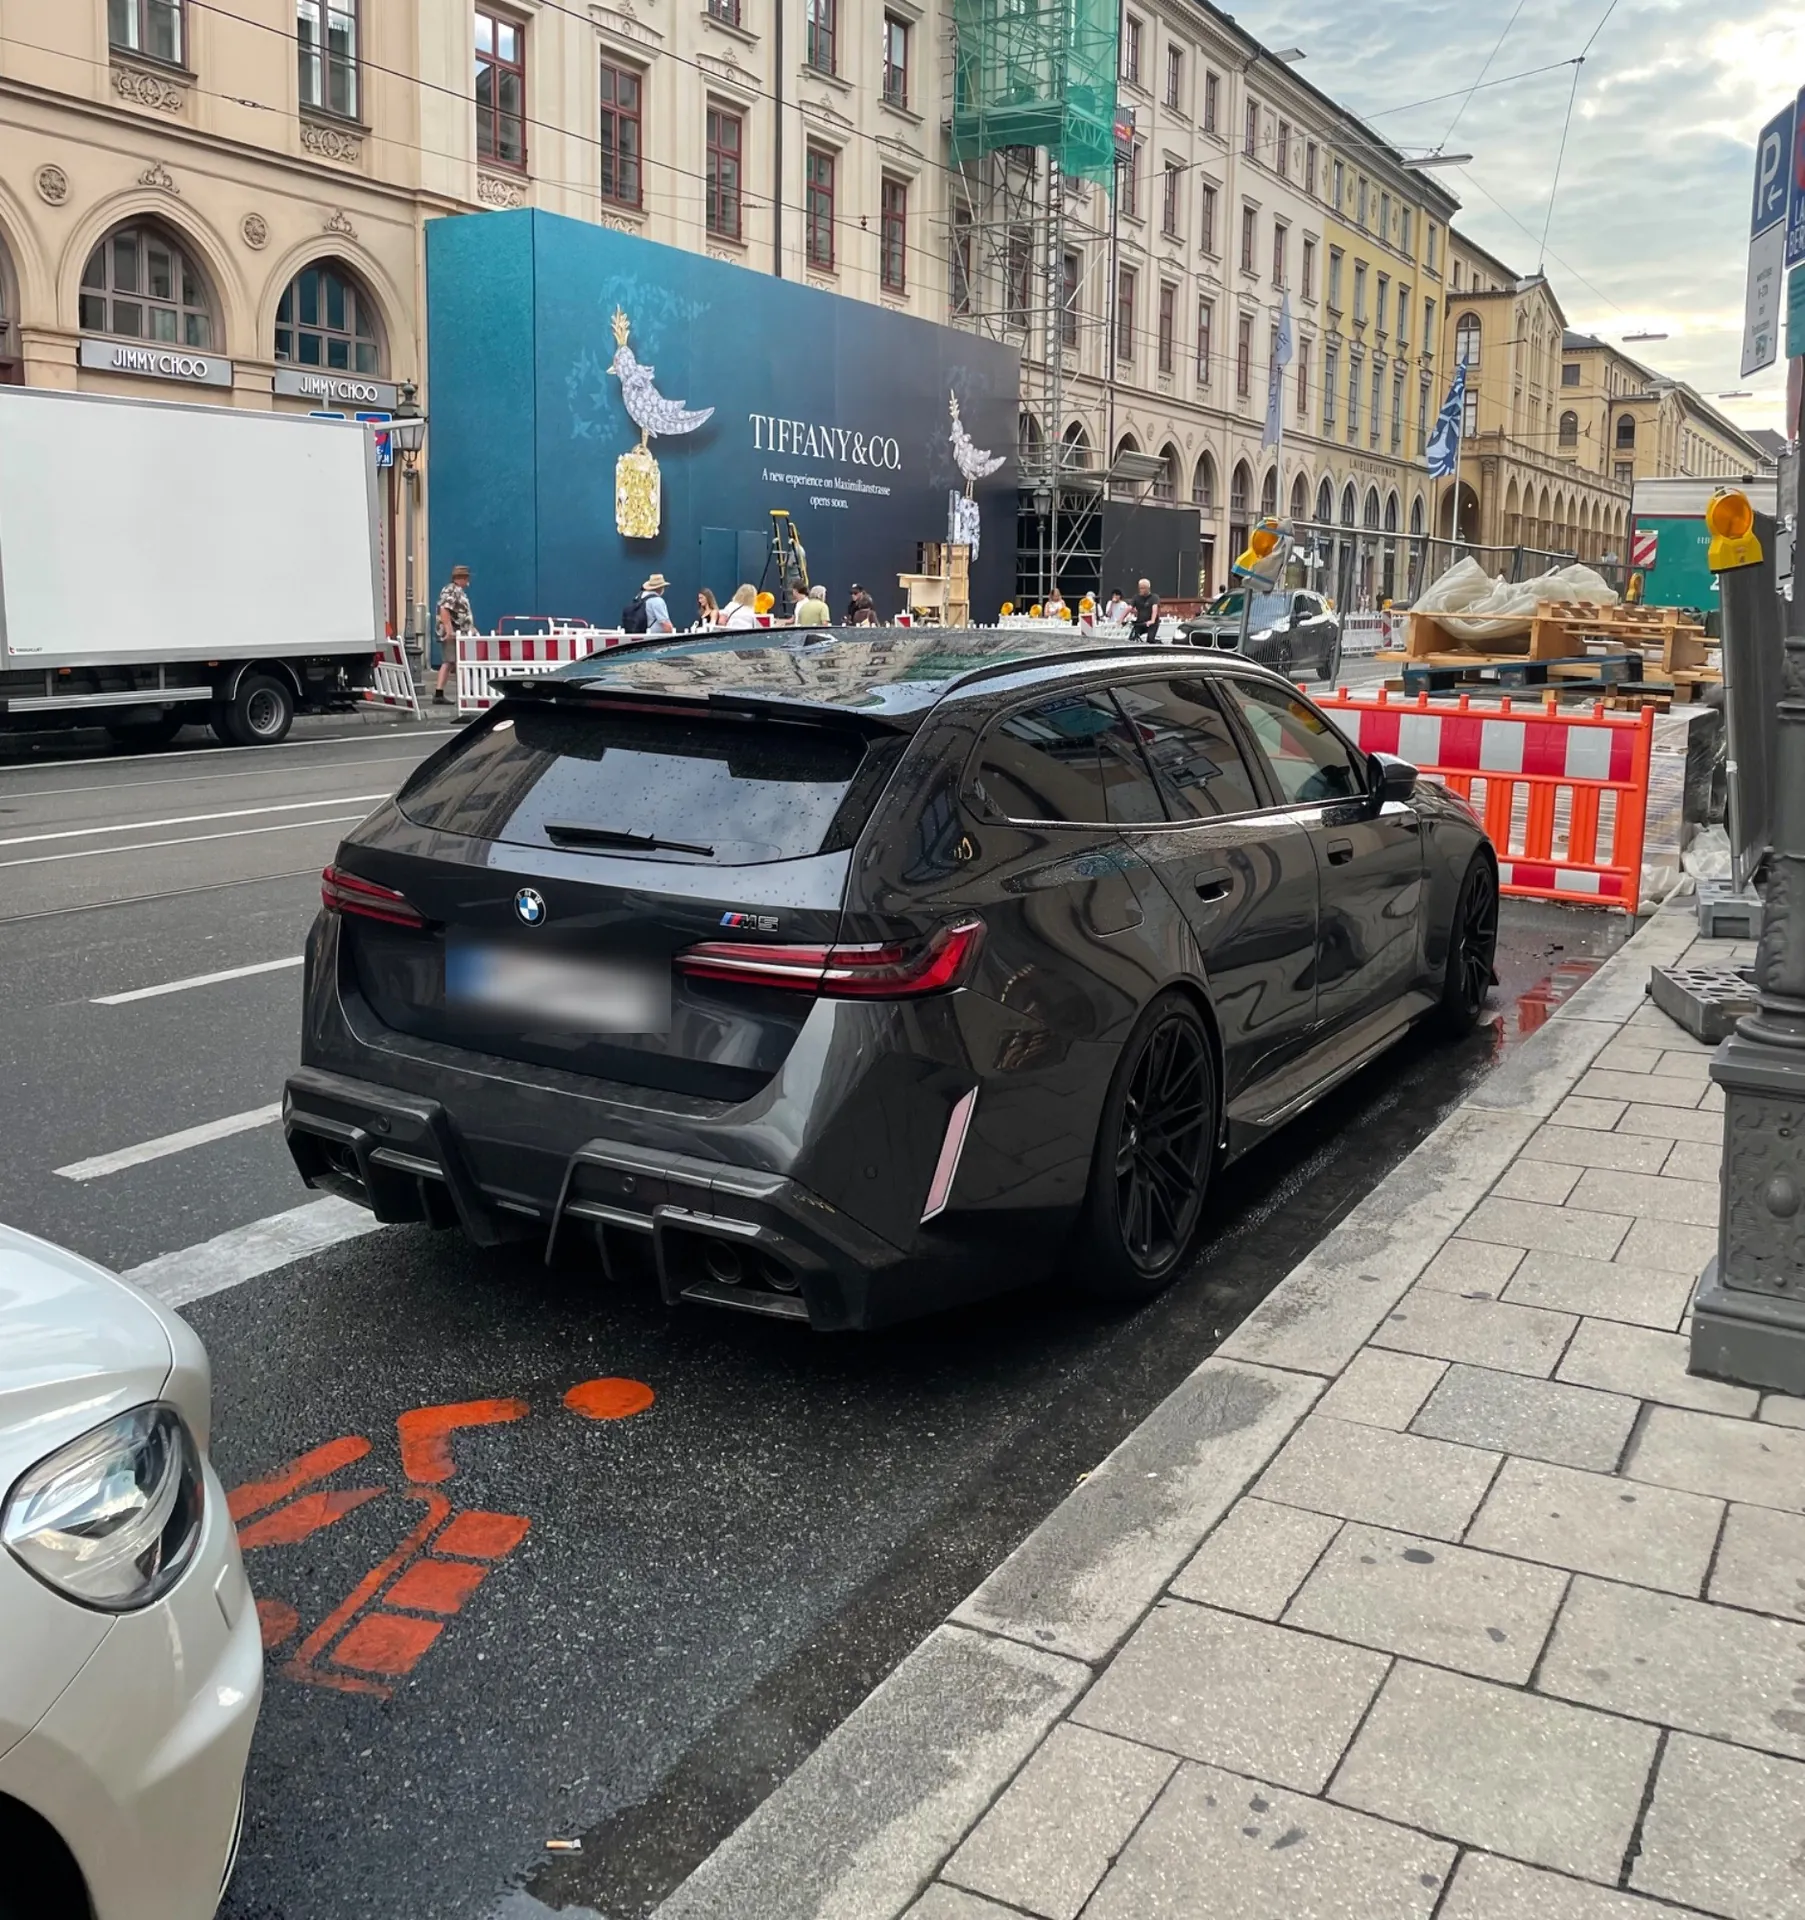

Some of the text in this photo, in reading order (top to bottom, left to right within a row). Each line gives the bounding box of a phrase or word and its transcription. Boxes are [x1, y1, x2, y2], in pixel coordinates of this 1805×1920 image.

[1757, 131, 1782, 221] P
[112, 349, 208, 378] JIMMY CHOO
[300, 376, 378, 402] JIMMY CHOO
[761, 467, 891, 496] A new experience on Maximilianstrasse
[809, 495, 849, 510] opens soon.
[732, 912, 780, 932] M5
